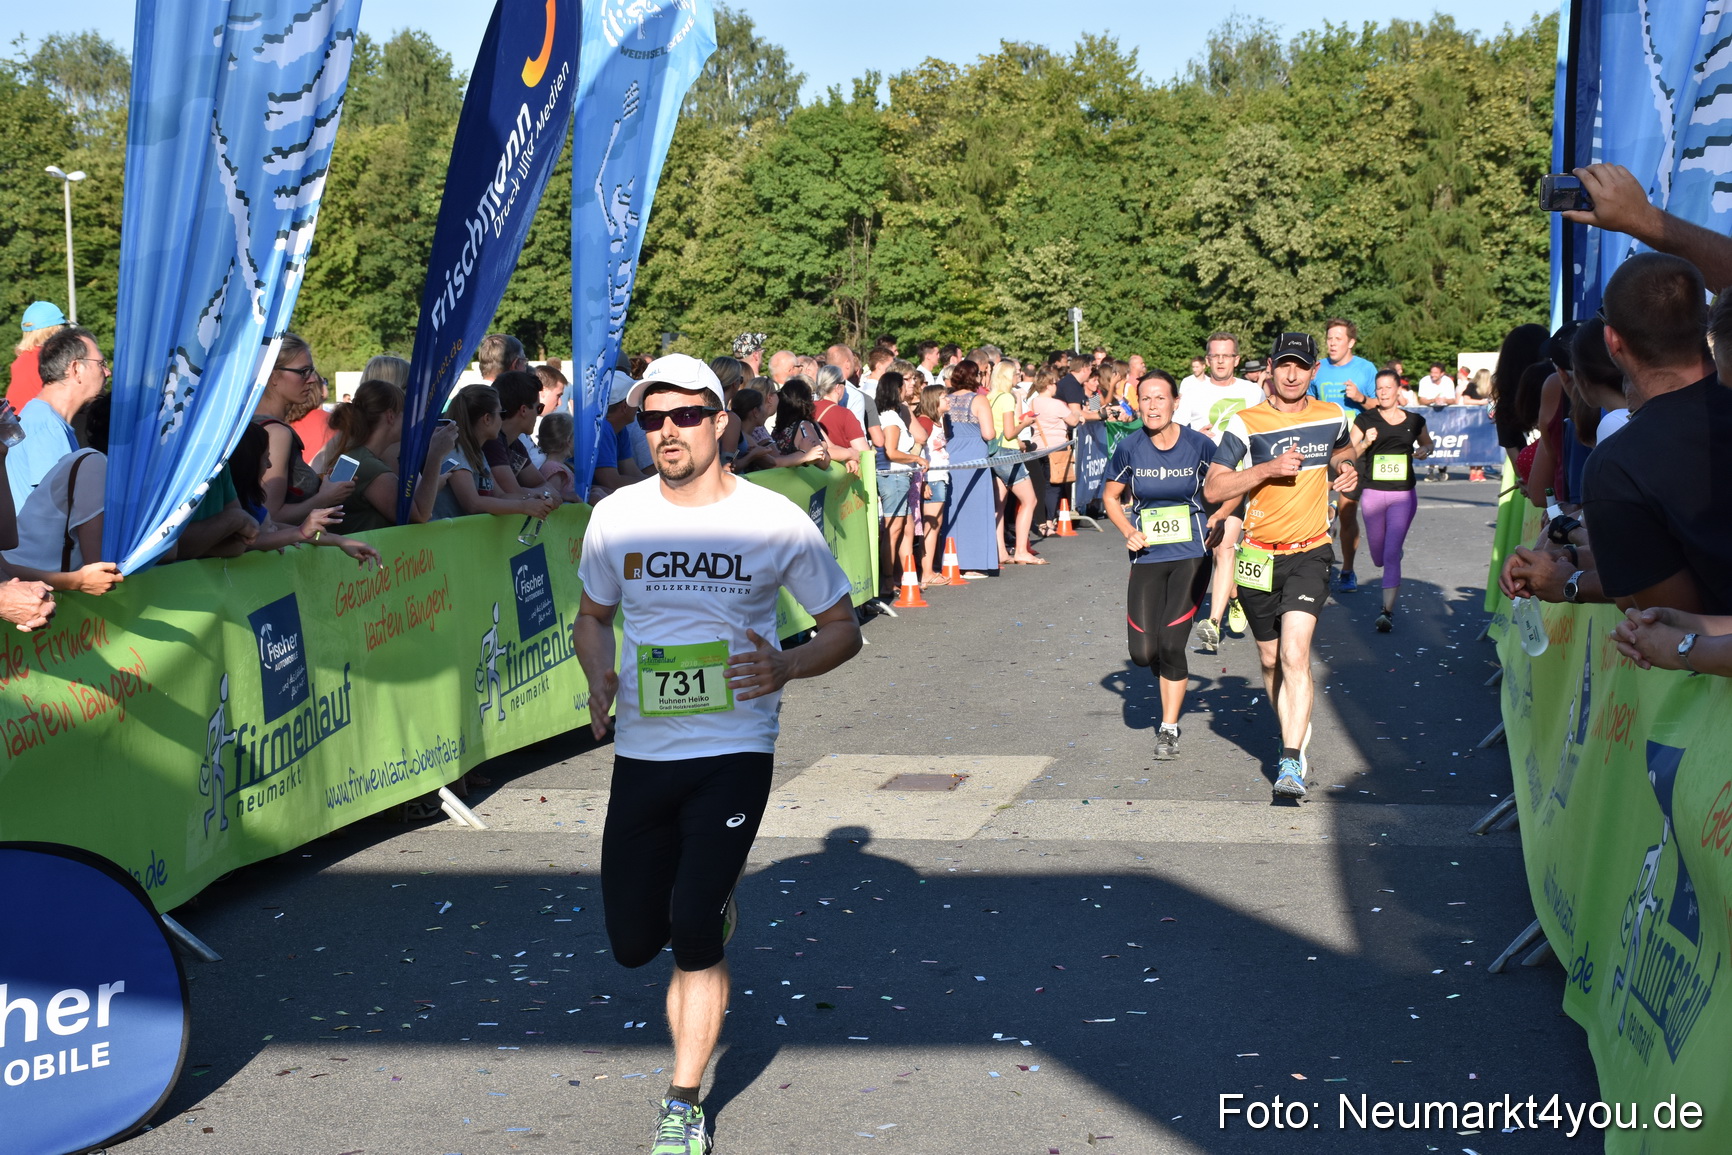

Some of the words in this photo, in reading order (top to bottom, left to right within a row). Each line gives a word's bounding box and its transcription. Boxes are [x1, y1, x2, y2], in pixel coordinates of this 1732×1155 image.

[620, 45, 668, 60] WECHSEL
[493, 177, 520, 239] Druck
[517, 132, 536, 180] und
[536, 61, 570, 140] Medien
[1135, 468, 1159, 477] EURO
[1167, 467, 1194, 477] POLES
[1380, 463, 1400, 473] 856
[1152, 519, 1180, 534] 498
[394, 551, 435, 588] Firmen
[646, 551, 752, 582] GRADL
[1238, 560, 1262, 578] 556
[520, 574, 544, 596] Fischer
[646, 584, 751, 595] HOLZKREATIONEN
[364, 603, 405, 653] laufen
[405, 573, 453, 633] länger!
[32, 616, 110, 673] Firmen
[267, 632, 298, 662] Fischer
[506, 612, 576, 691] firmenla
[274, 651, 299, 673] AUTOMOBILE
[510, 674, 550, 712] neumarkt
[655, 669, 706, 697] 731
[0, 693, 77, 760] laufen
[67, 646, 153, 723] länger!
[659, 697, 687, 705] Huhnen
[688, 695, 710, 703] Heiko
[234, 661, 351, 790] firmenlauf
[236, 764, 302, 818] neumarkt
